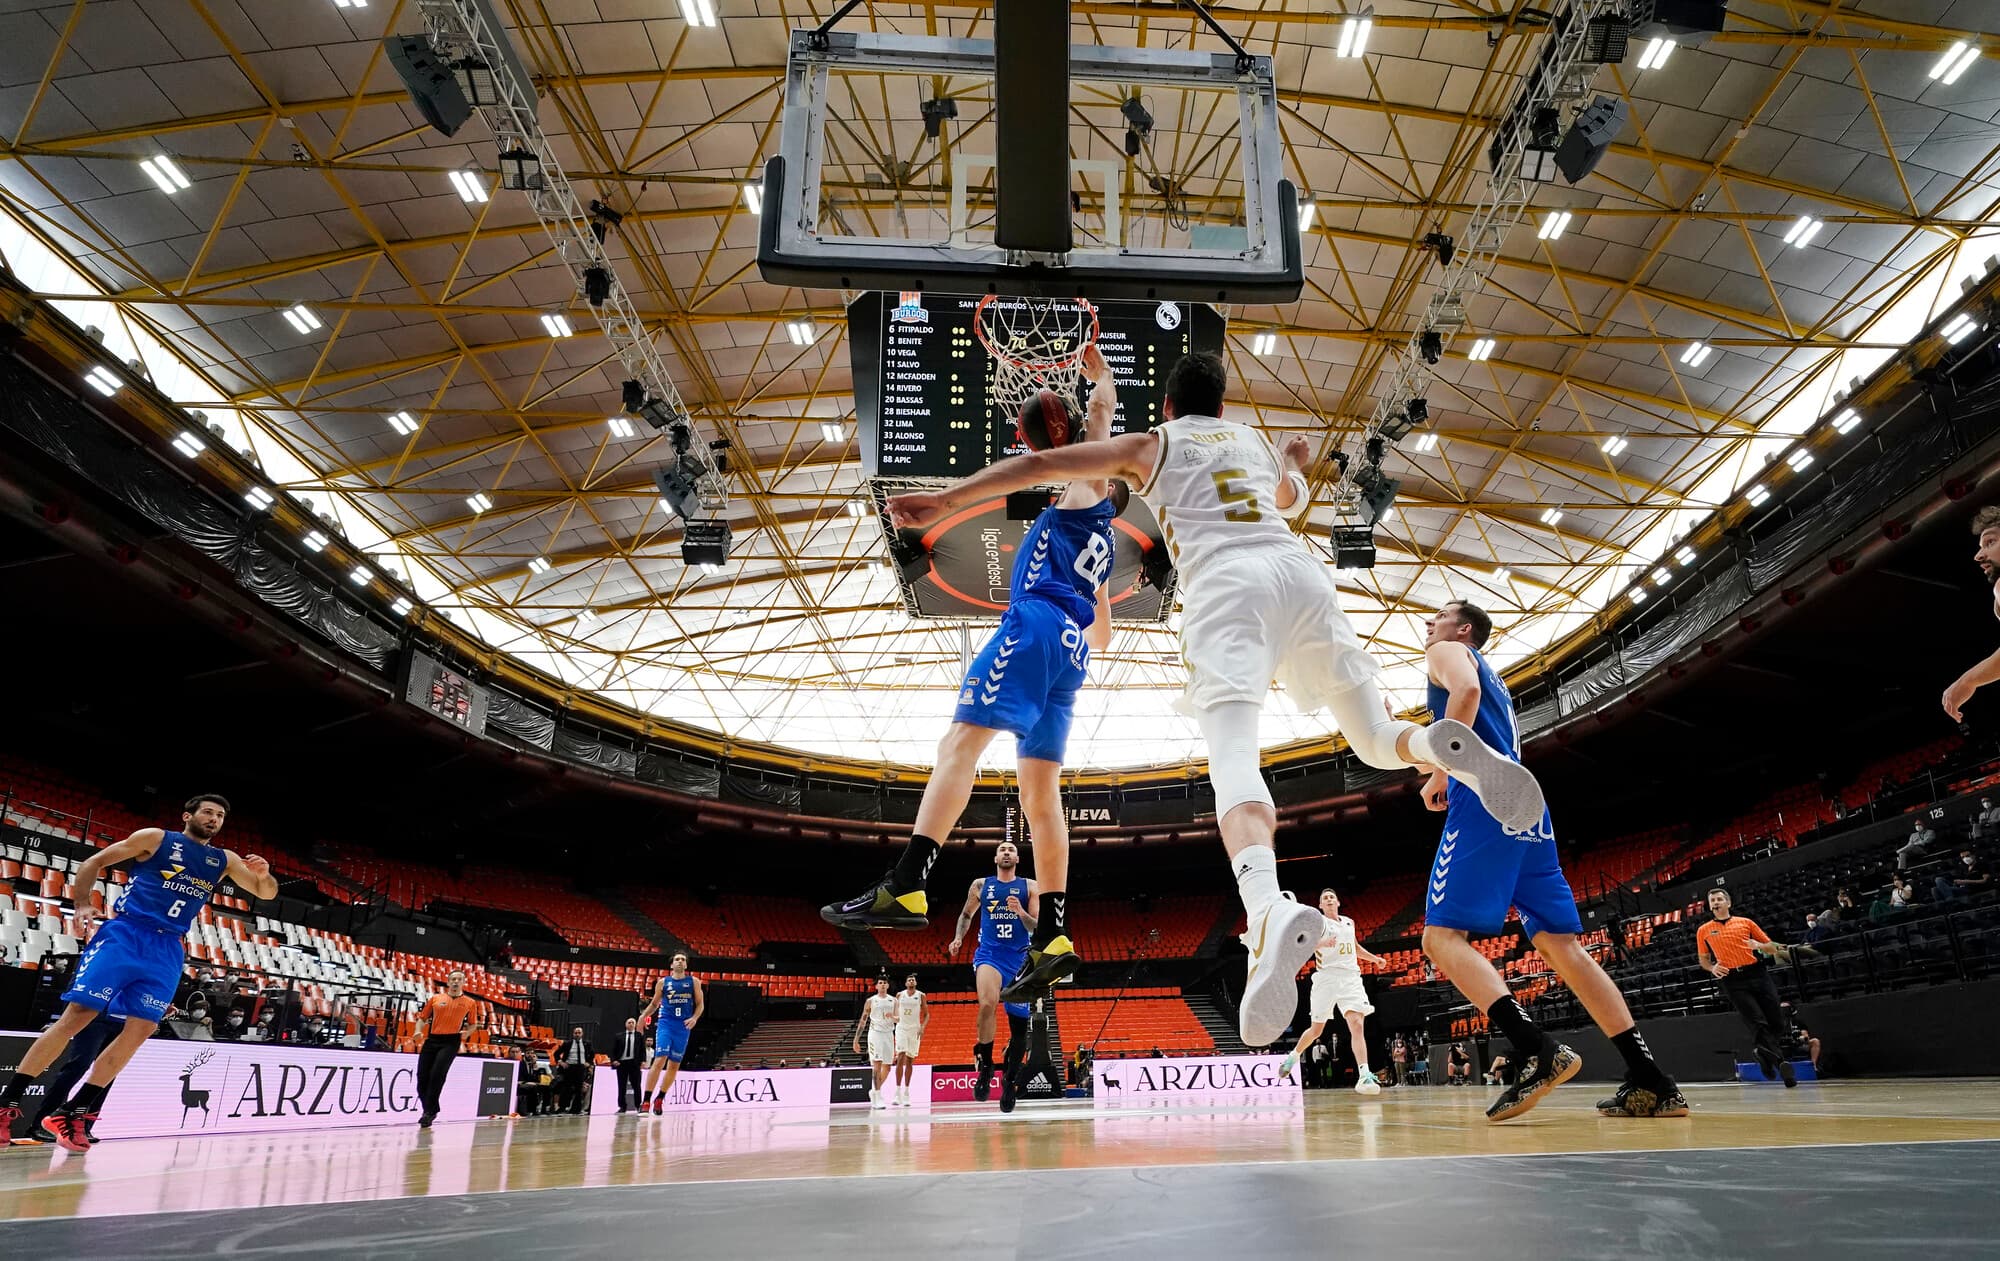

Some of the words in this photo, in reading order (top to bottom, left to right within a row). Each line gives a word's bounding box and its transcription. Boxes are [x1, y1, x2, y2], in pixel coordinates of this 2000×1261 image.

[889, 325, 895, 333] 6
[888, 336, 895, 345] 8
[1098, 332, 1126, 340] AUSEUR
[1182, 334, 1188, 342] 2
[1054, 340, 1070, 350] 67
[1182, 345, 1188, 354] 8
[986, 362, 992, 371] 3
[985, 374, 995, 382] 14
[985, 386, 994, 394] 10
[985, 398, 994, 406] 10
[986, 409, 992, 418] 0
[985, 421, 992, 430] 4
[895, 432, 924, 440] ALONSO
[985, 433, 992, 442] 0
[894, 444, 926, 452] AGUILAR
[985, 445, 992, 454] 8
[985, 457, 991, 466] 5
[1211, 468, 1263, 522] 5
[1930, 808, 1944, 819] 125
[24, 836, 41, 848] 110
[162, 880, 205, 900] BURGOS
[222, 885, 234, 895] 109
[168, 900, 186, 918] 6
[996, 924, 1013, 938] 32
[1340, 943, 1352, 954] 20
[934, 1074, 1000, 1090] endea
[1133, 1063, 1299, 1092] ARZUAGA
[228, 1063, 419, 1117] ARZUAG
[669, 1078, 780, 1105] ARZUAGA
